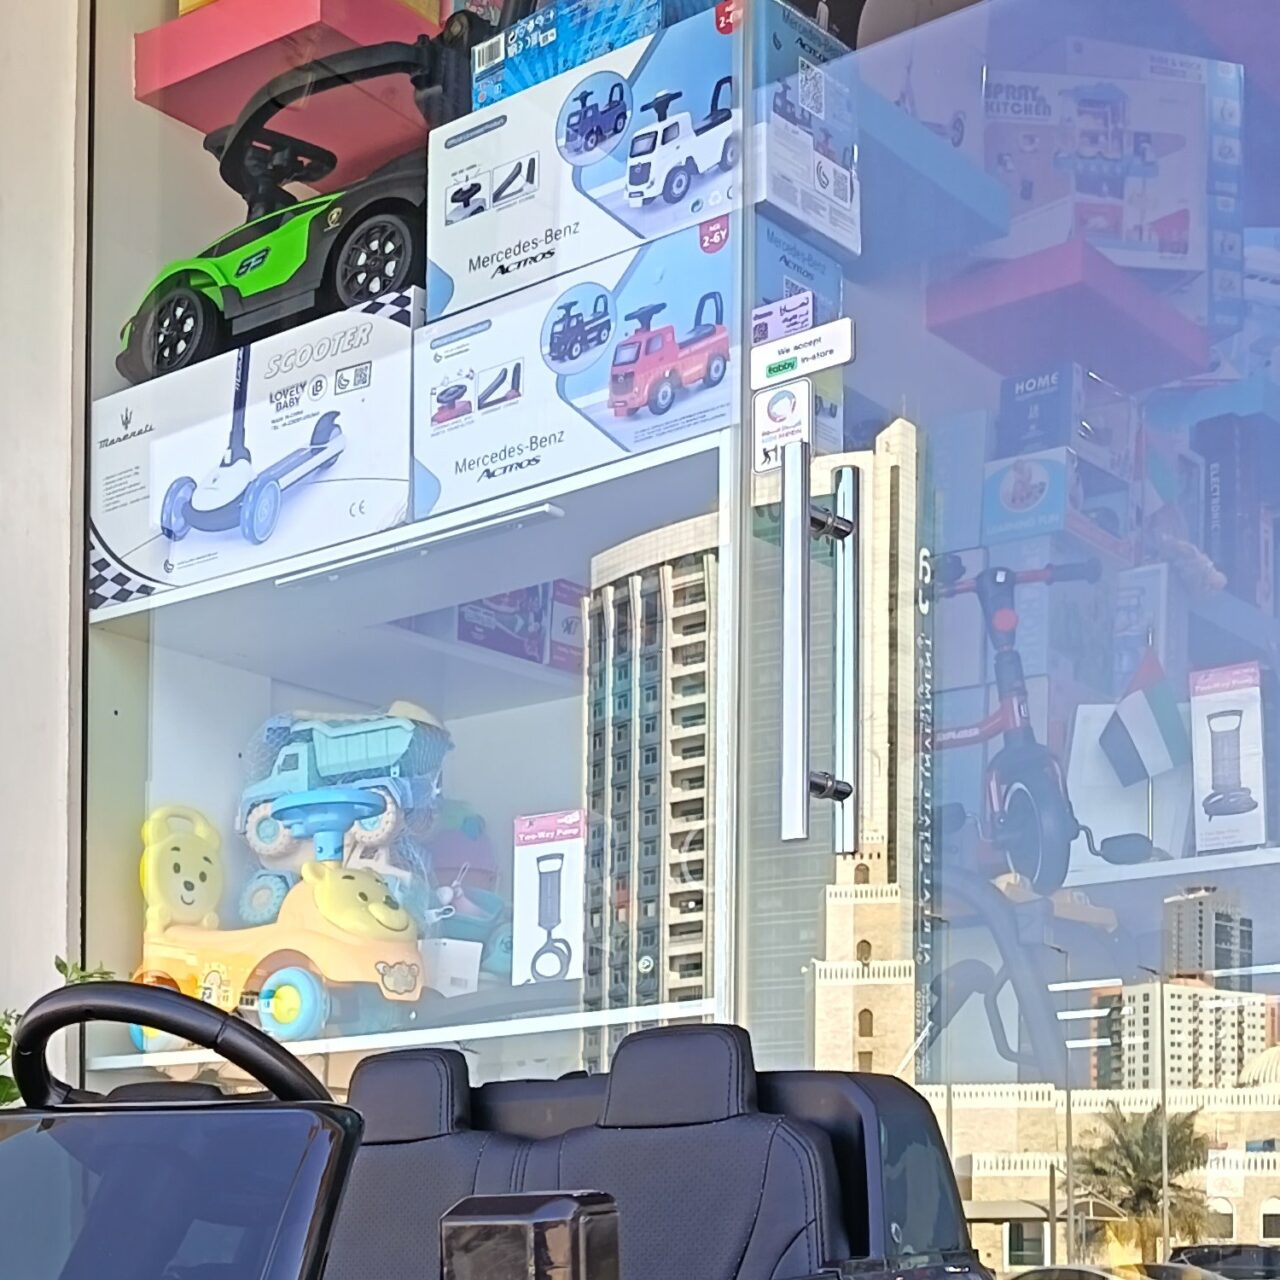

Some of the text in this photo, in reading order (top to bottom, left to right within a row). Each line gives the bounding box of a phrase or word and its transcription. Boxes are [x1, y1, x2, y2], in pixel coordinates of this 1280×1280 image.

[468, 221, 580, 274] Mercedes-Benz
[263, 321, 374, 380] SCOOTER
[793, 336, 822, 351] accept
[768, 359, 796, 375] tabby
[269, 380, 308, 404] LOVELY
[1015, 371, 1061, 396] HOME
[275, 395, 301, 412] BABY
[97, 424, 156, 450] Maserati
[453, 429, 566, 475] Mercedes-Benz
